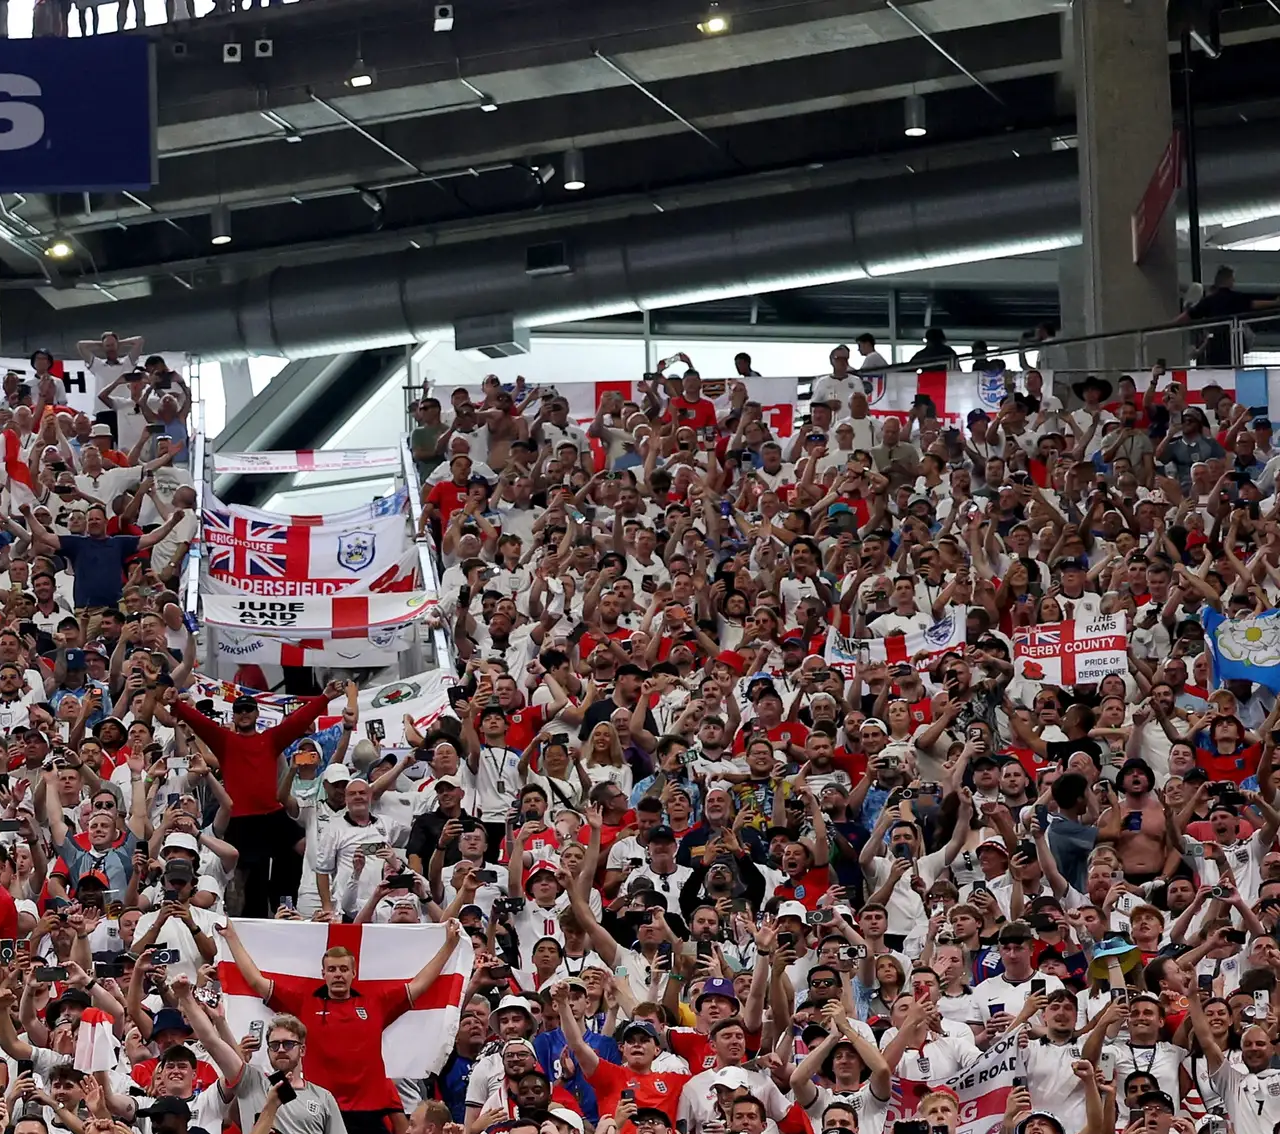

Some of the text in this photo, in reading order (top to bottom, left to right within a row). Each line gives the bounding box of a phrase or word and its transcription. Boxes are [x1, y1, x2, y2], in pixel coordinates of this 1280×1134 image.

[209, 532, 274, 554] BRIGHOUSE
[232, 601, 305, 612] JUDE
[239, 611, 298, 621] AND
[1085, 621, 1117, 633] RAMS
[1020, 637, 1116, 657] DERBY COUNTY
[1084, 656, 1121, 666] PRIDE OF
[543, 919, 555, 936] 10
[1255, 1099, 1265, 1116] 7
